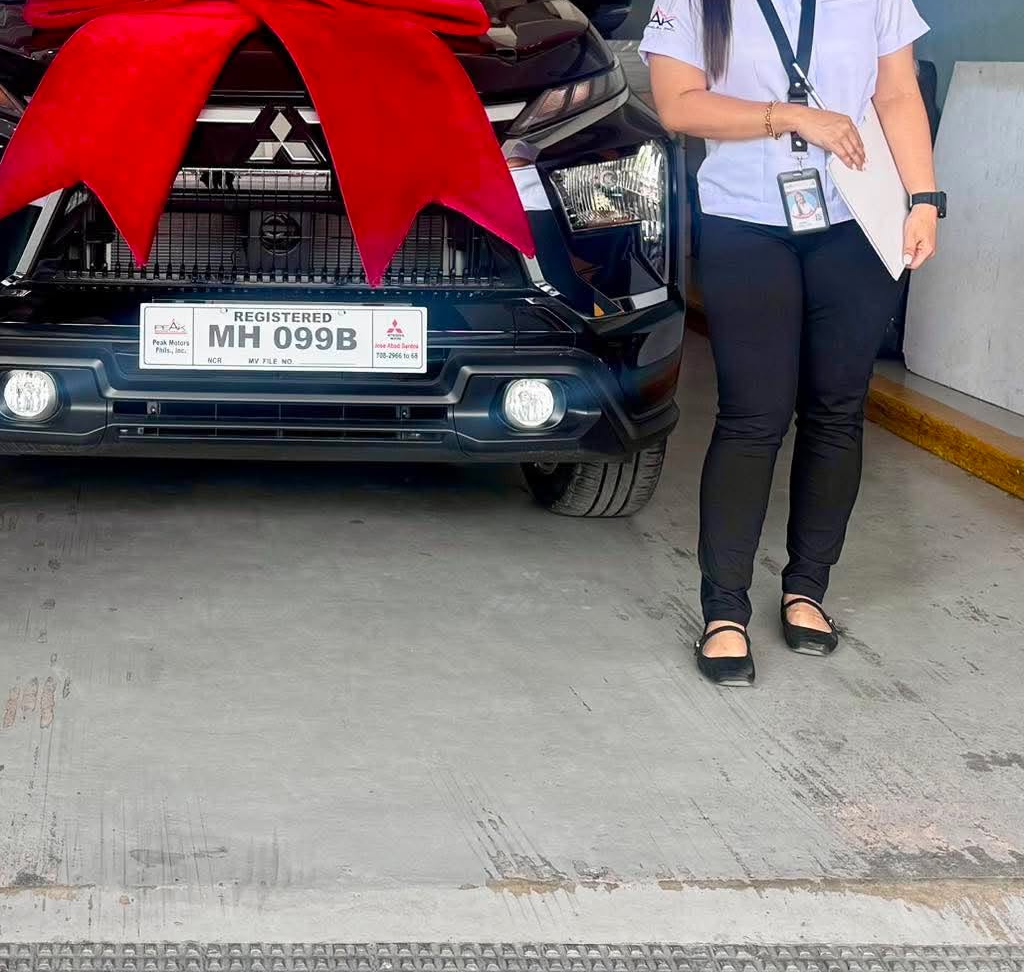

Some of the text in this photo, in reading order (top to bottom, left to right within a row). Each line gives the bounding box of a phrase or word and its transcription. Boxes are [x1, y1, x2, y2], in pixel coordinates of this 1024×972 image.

[233, 311, 333, 324] REGISTERED
[169, 339, 190, 347] Motors
[208, 324, 358, 351] MH 099B
